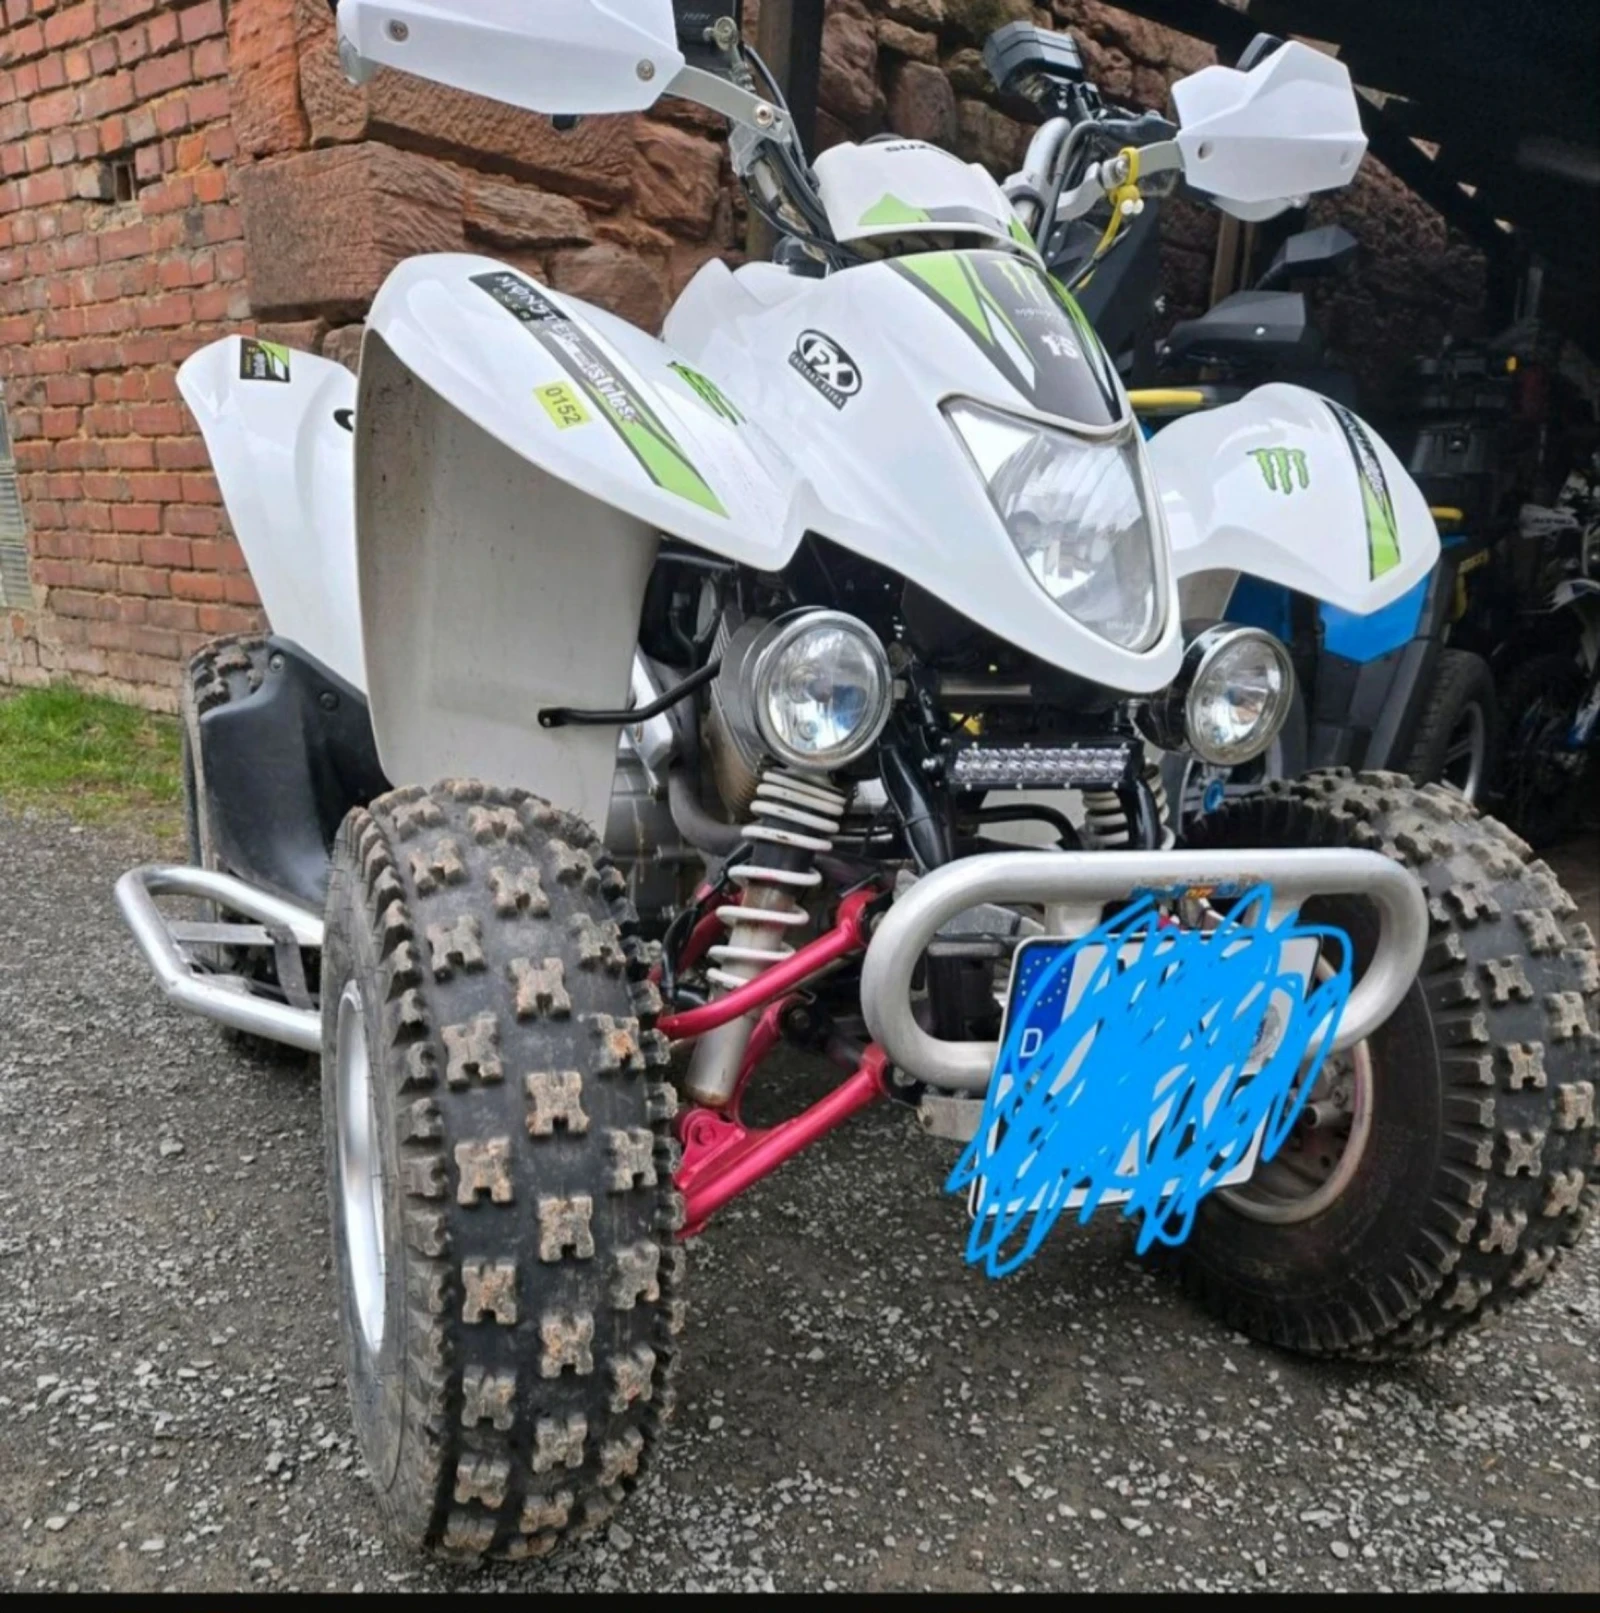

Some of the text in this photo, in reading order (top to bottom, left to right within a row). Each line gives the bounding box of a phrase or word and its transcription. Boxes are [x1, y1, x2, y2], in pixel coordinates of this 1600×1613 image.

[802, 338, 856, 390] FX
[545, 387, 581, 425] 0152
[1020, 1028, 1043, 1057] D
